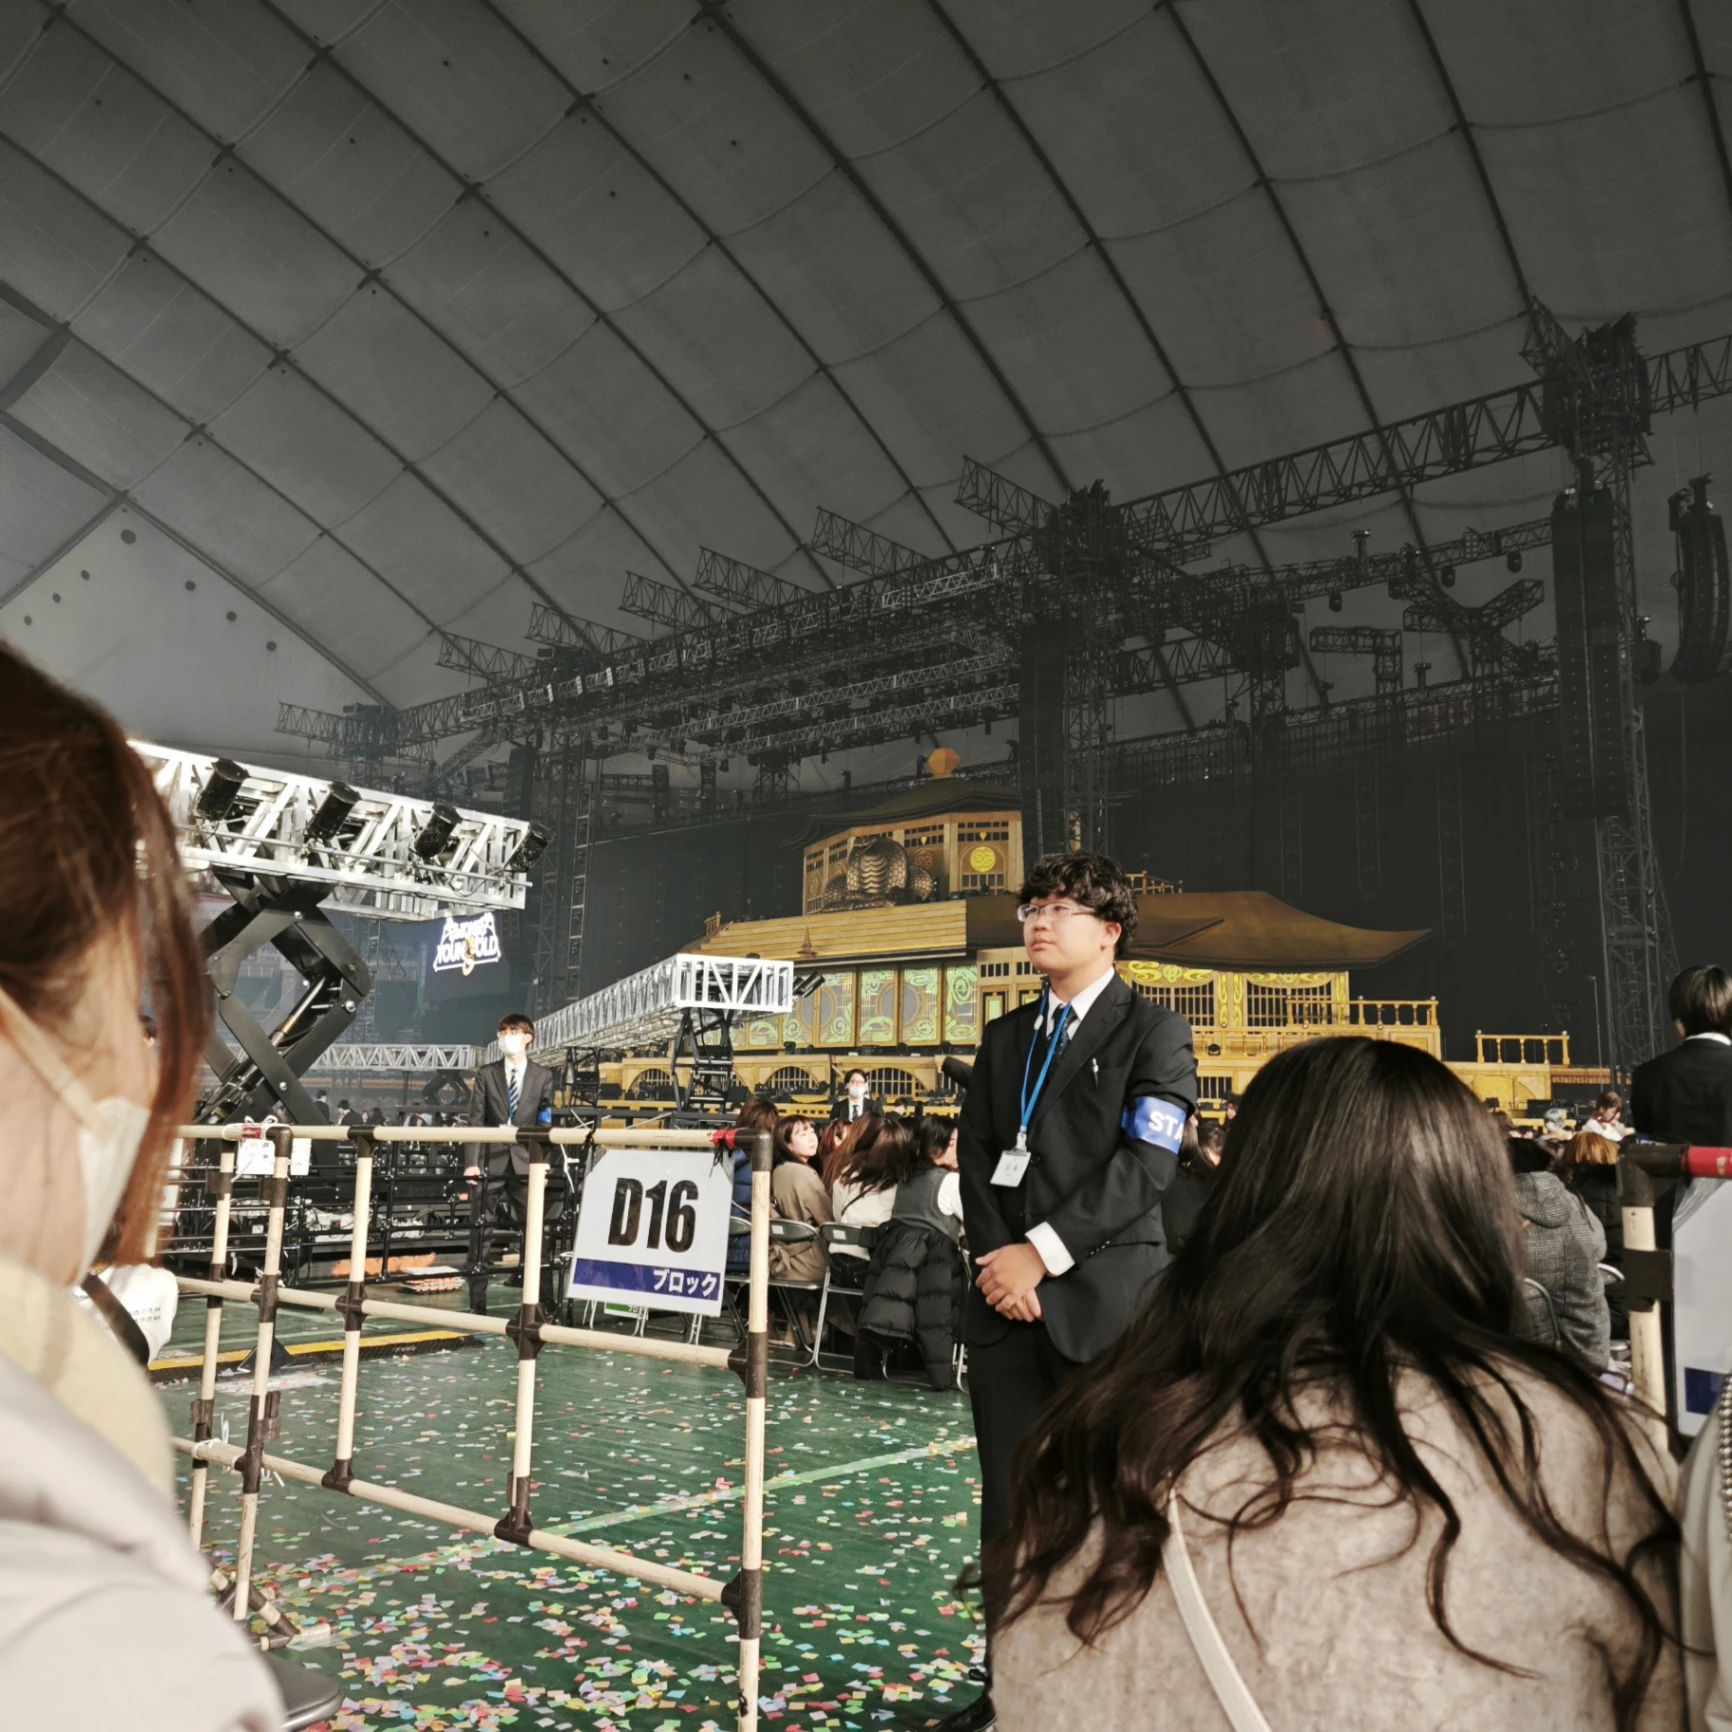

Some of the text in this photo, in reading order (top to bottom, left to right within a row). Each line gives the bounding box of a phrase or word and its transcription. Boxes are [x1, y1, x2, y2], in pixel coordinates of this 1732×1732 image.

[608, 1178, 698, 1252] D16
[653, 1269, 717, 1296] ブロック
